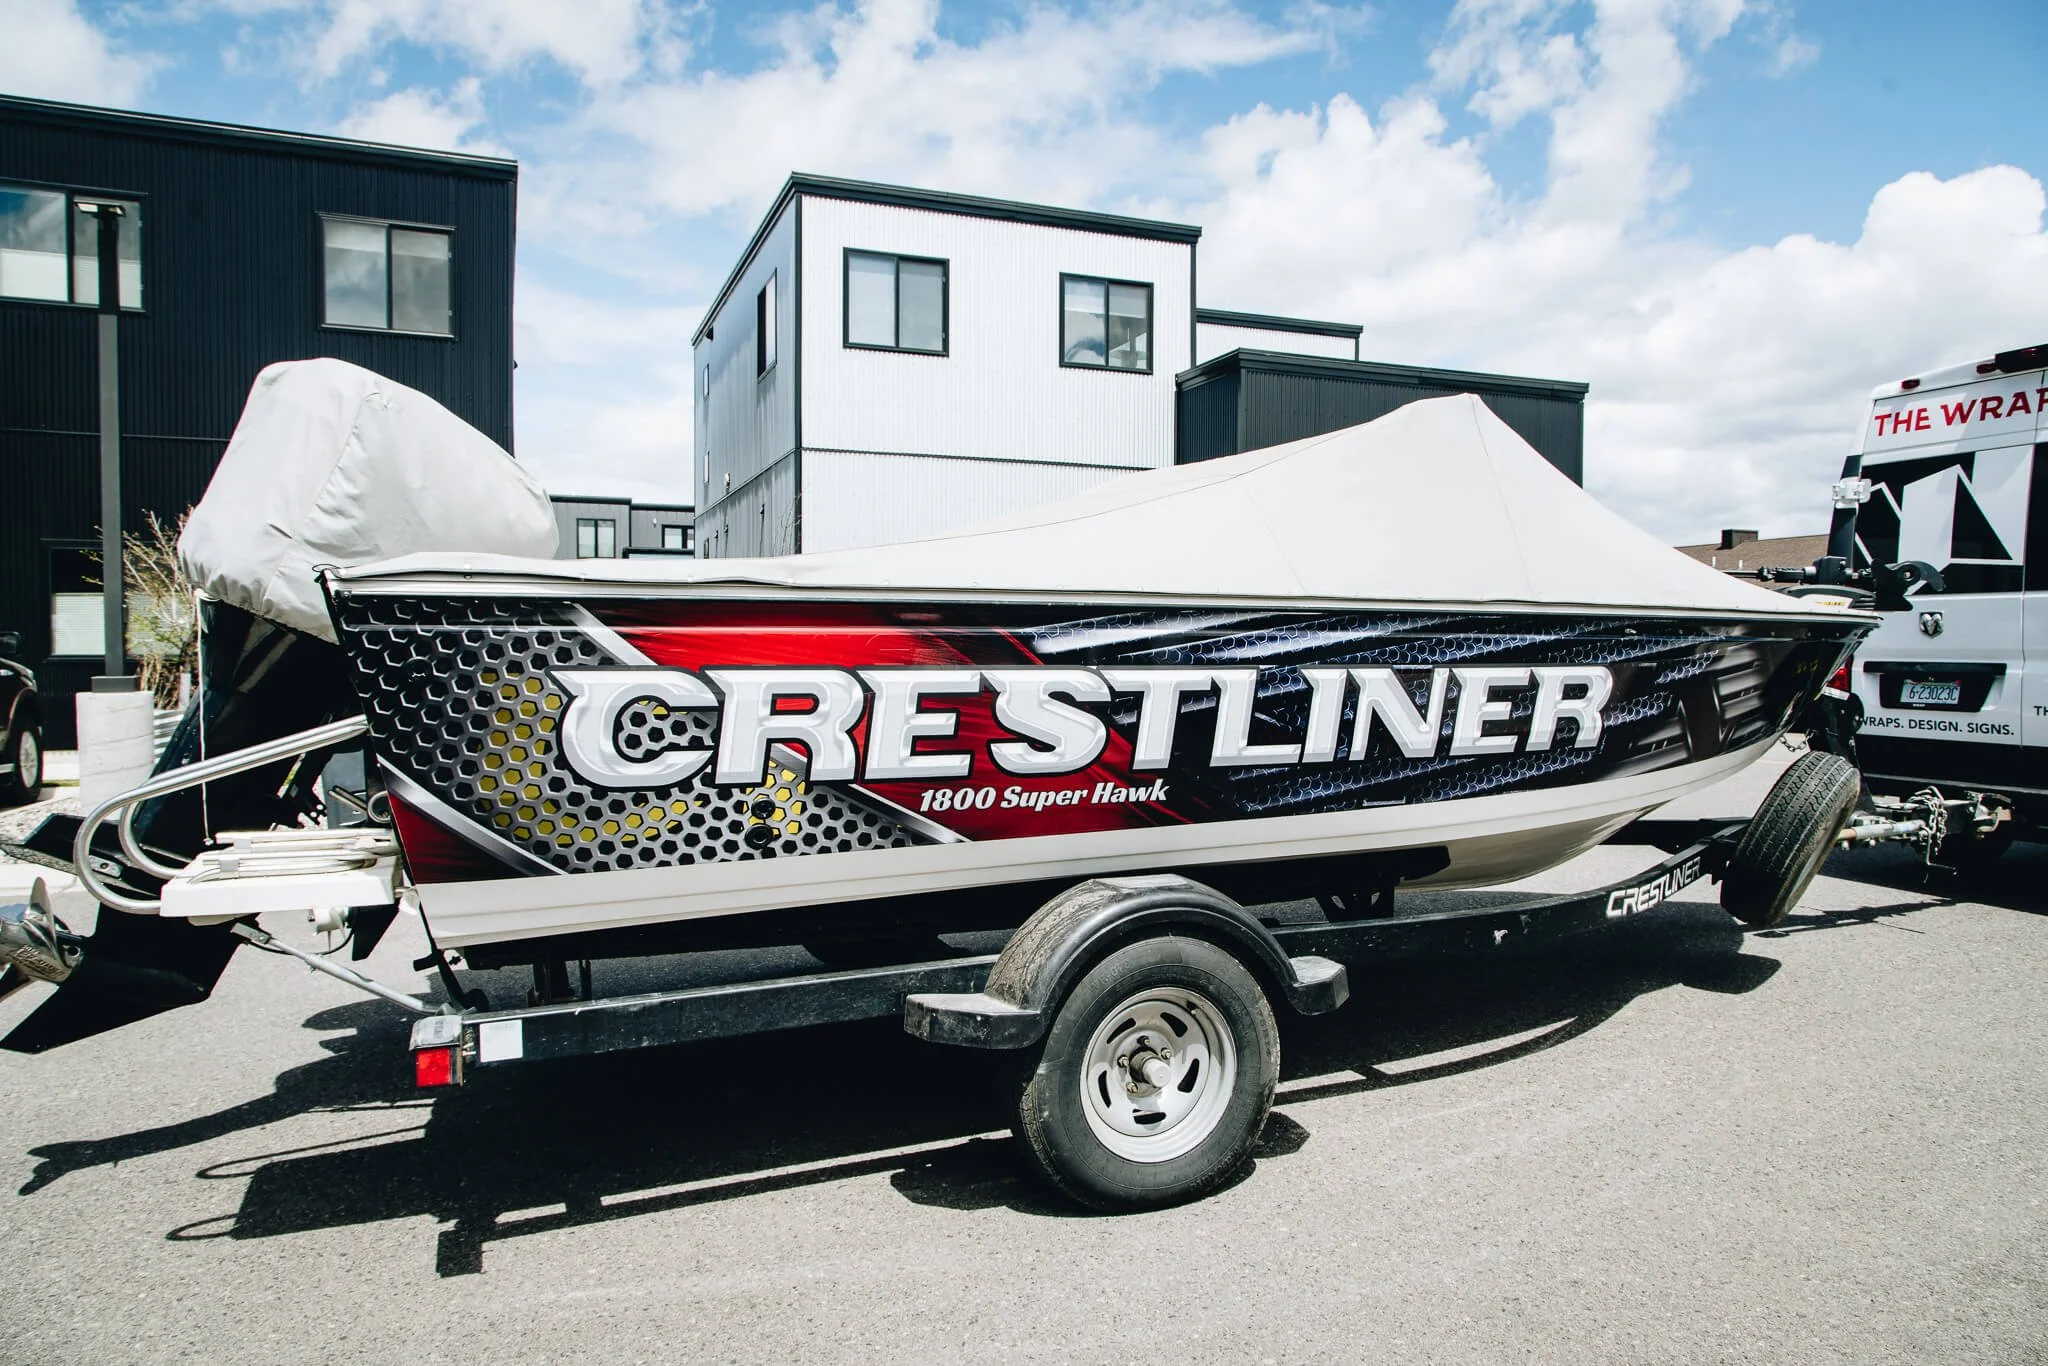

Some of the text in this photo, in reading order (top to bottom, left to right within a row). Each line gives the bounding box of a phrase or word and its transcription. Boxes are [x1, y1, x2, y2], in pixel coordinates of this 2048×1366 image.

[1874, 408, 1931, 437] THE
[546, 665, 1614, 790] CRESTLINER
[1908, 719, 1963, 733] DESIGN.
[1967, 722, 2015, 736] SIGNS.
[919, 778, 1170, 813] 1800 Super Hawk
[1606, 856, 1701, 918] CRESTLINER
